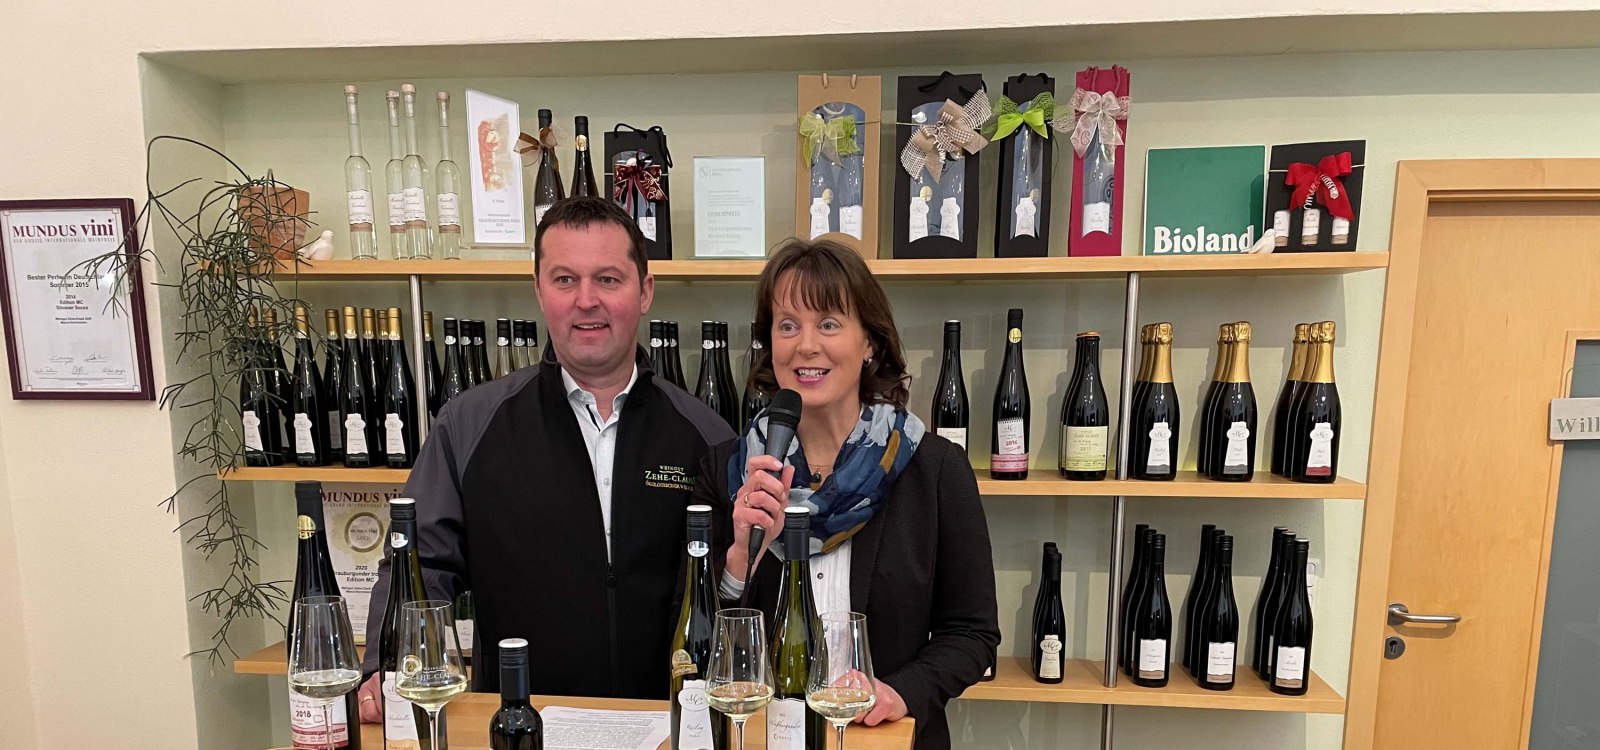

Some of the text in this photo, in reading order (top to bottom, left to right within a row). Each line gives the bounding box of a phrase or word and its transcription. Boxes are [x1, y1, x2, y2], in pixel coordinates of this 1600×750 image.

[13, 219, 114, 237] MUNDUS vini
[1154, 225, 1254, 253] Bioland
[321, 492, 379, 502] MUNDUS
